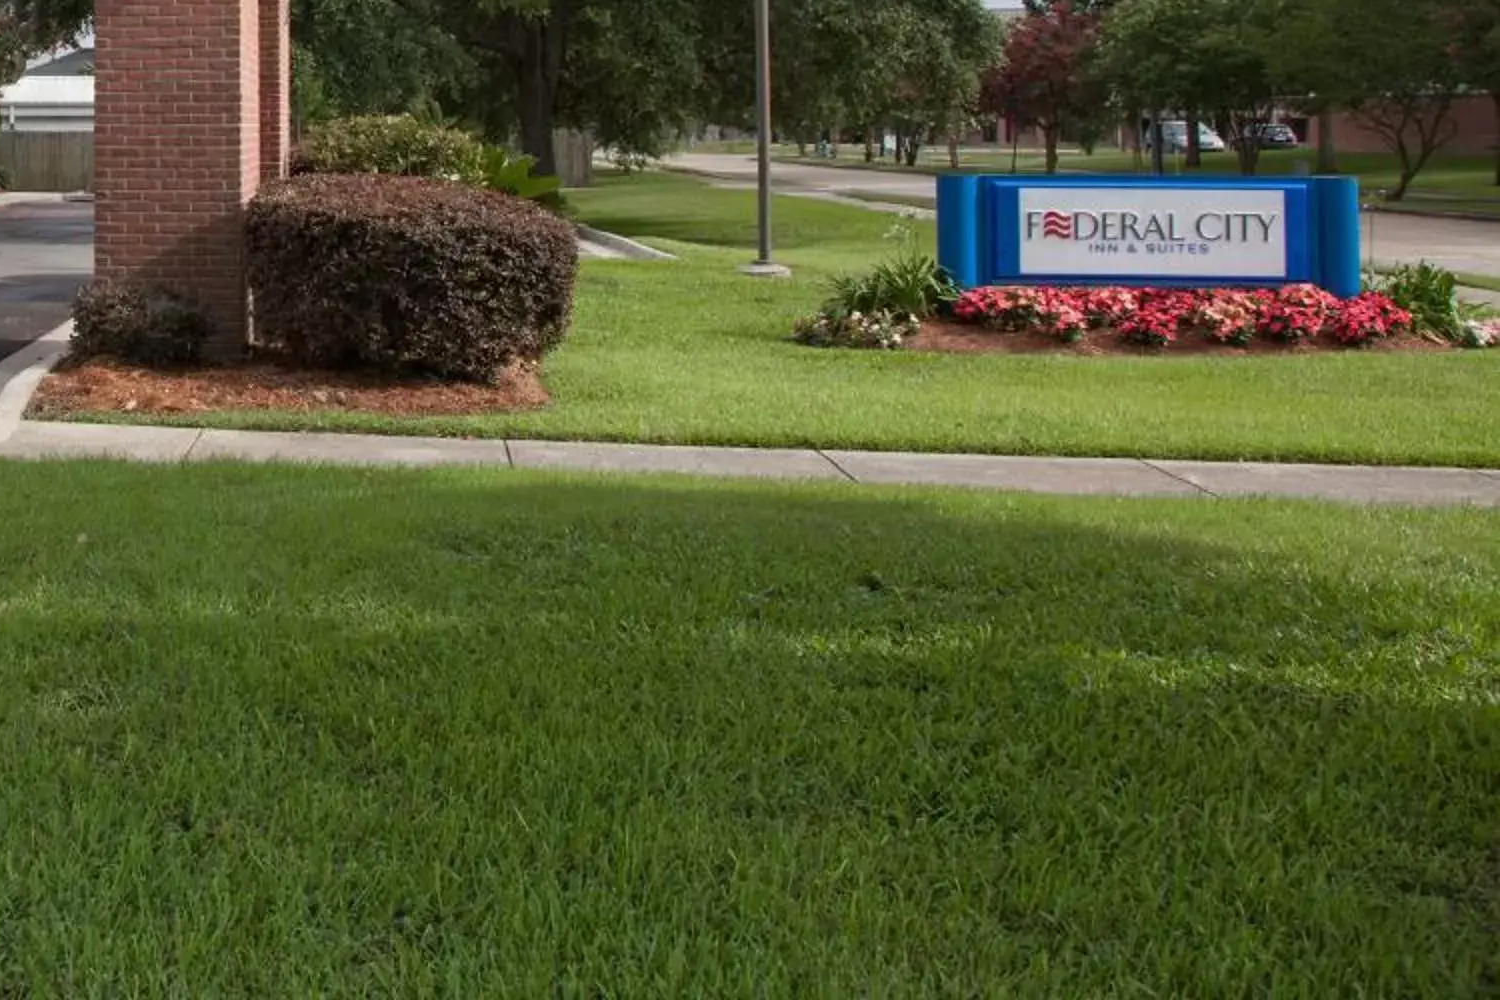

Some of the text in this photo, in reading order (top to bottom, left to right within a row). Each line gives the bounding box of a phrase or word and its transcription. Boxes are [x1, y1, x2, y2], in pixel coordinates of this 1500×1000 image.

[1026, 210, 1278, 242] FEDERAL CITY
[1088, 243, 1211, 255] INN & SUITES
